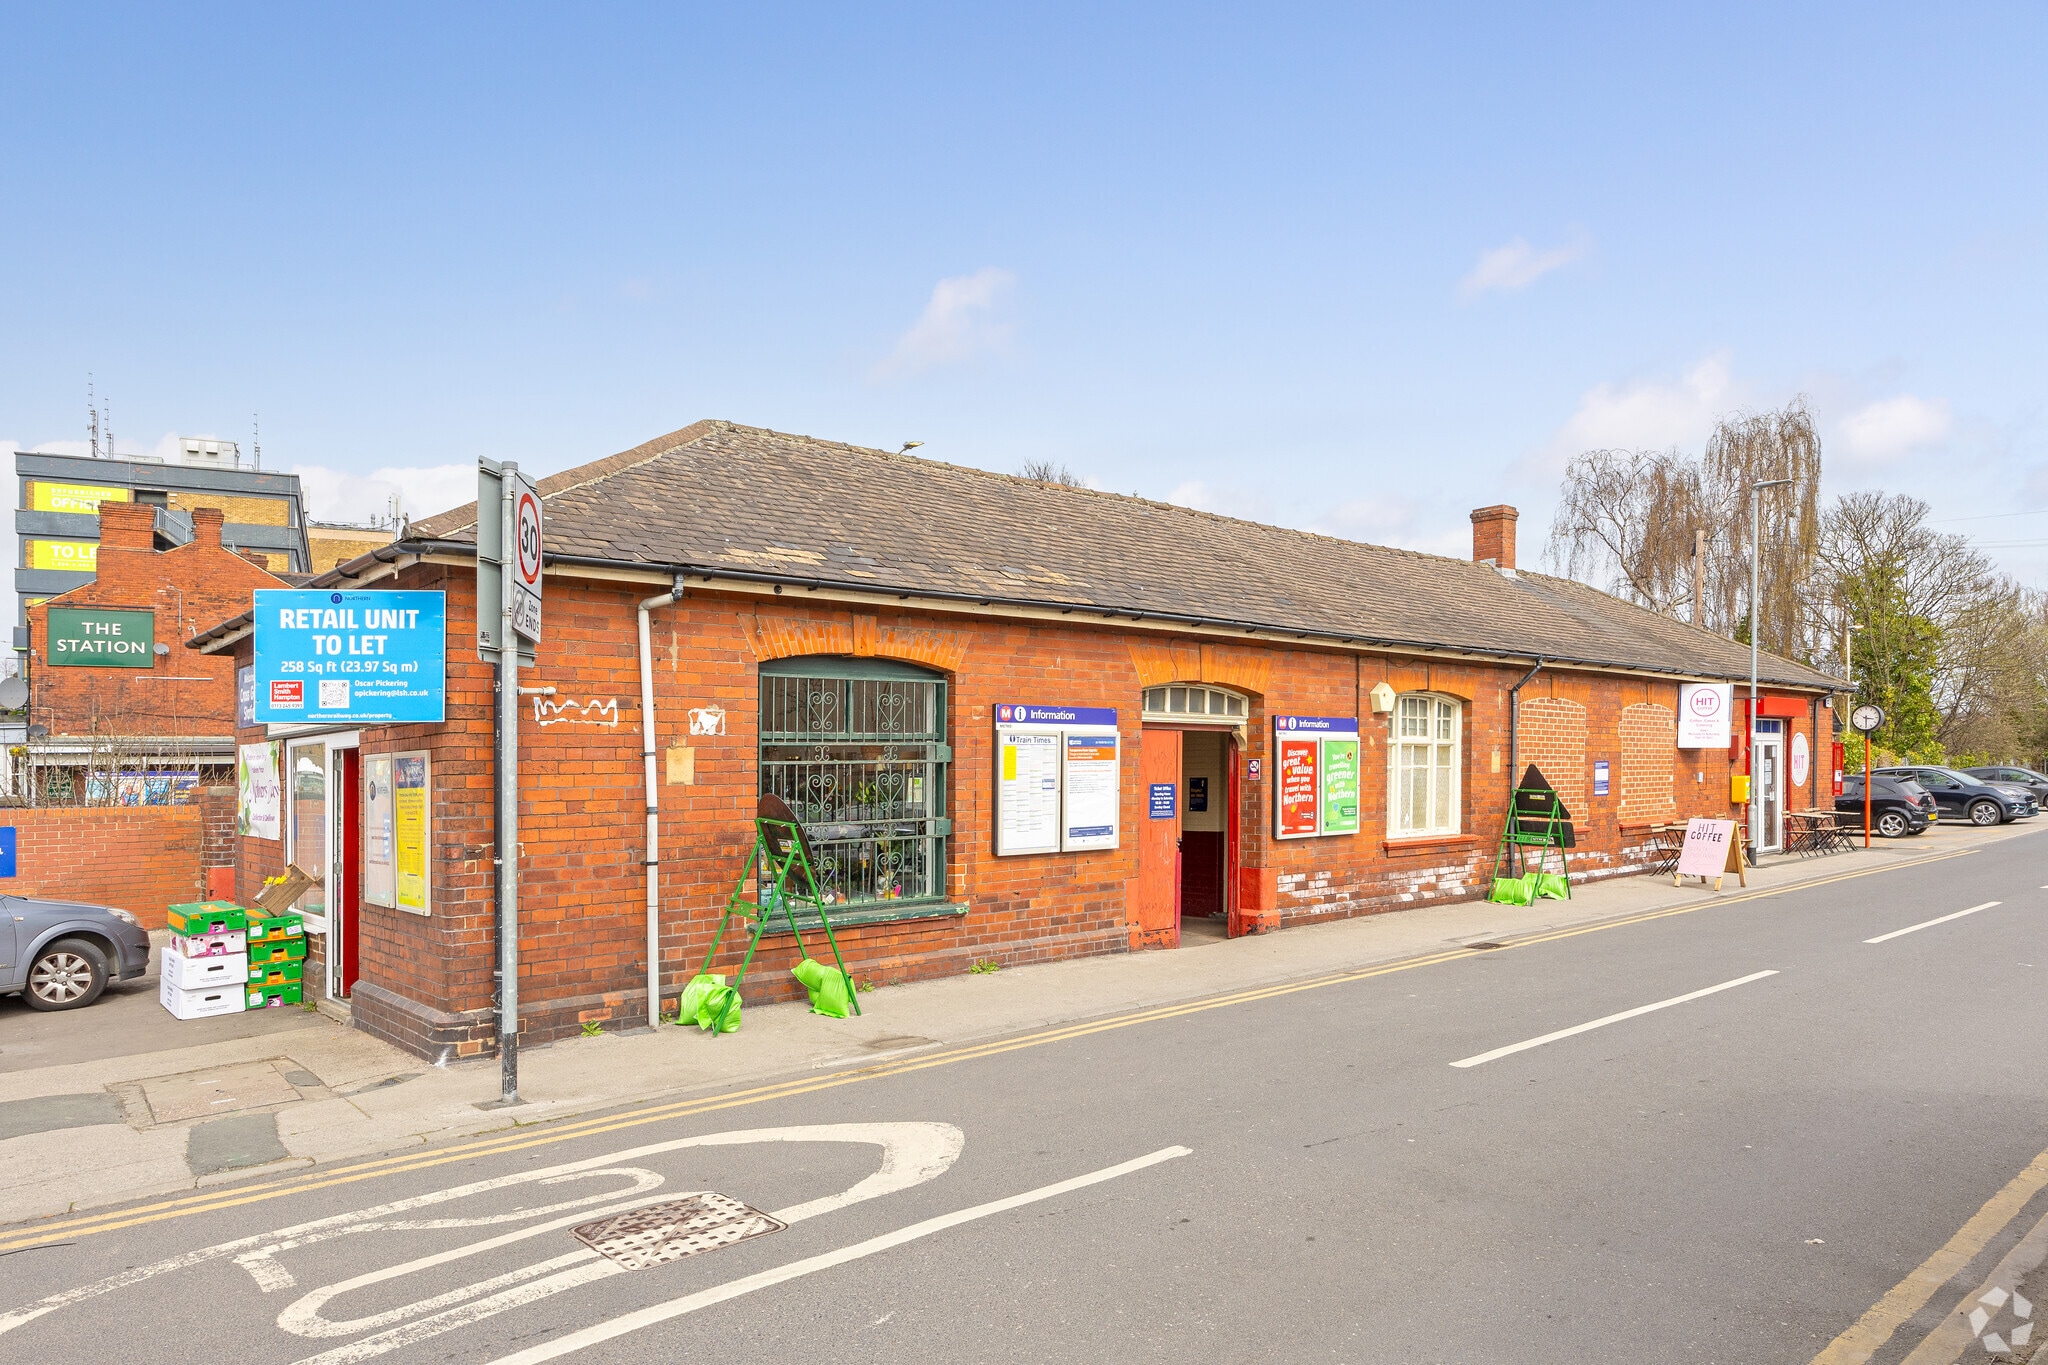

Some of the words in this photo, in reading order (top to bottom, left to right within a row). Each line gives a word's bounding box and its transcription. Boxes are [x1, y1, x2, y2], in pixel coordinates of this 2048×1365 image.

[521, 516, 538, 561] 30
[50, 545, 74, 559] TO
[78, 545, 97, 559] LE
[528, 599, 538, 616] Zone
[280, 608, 358, 630] RETAIL
[365, 609, 420, 630] UNIT
[525, 613, 540, 635] ENDS
[81, 622, 122, 636] THE
[57, 639, 146, 655] STATION
[312, 635, 342, 655] TO
[349, 635, 388, 655] LET
[281, 660, 304, 673] 258
[307, 660, 323, 675] Sq
[327, 660, 337, 673] ft
[341, 660, 380, 674] (23.97
[382, 660, 398, 675] Sq
[401, 660, 419, 674] m)
[375, 680, 408, 688] Pickering
[354, 689, 429, 697] opickering@lsh.co.uk
[1696, 697, 1715, 706] HIT
[307, 712, 393, 720] northernrailway.co.uk/property
[1030, 709, 1076, 720] Information
[1299, 720, 1330, 729] Information
[1016, 736, 1032, 744] Train
[1033, 736, 1051, 744] Times
[1287, 749, 1309, 757] Discover
[1283, 757, 1301, 769] great
[1328, 761, 1351, 771] travelling
[1793, 754, 1805, 770] HIT
[1292, 764, 1314, 775] value
[1286, 776, 1300, 784] when
[1326, 770, 1355, 785] greener
[1284, 784, 1299, 793] travel
[1299, 784, 1312, 792] with
[1334, 780, 1346, 789] with
[1283, 793, 1314, 805] Northern
[1327, 789, 1356, 802] Northern
[1698, 823, 1717, 833] HIT
[1690, 831, 1723, 843] COFFEE
